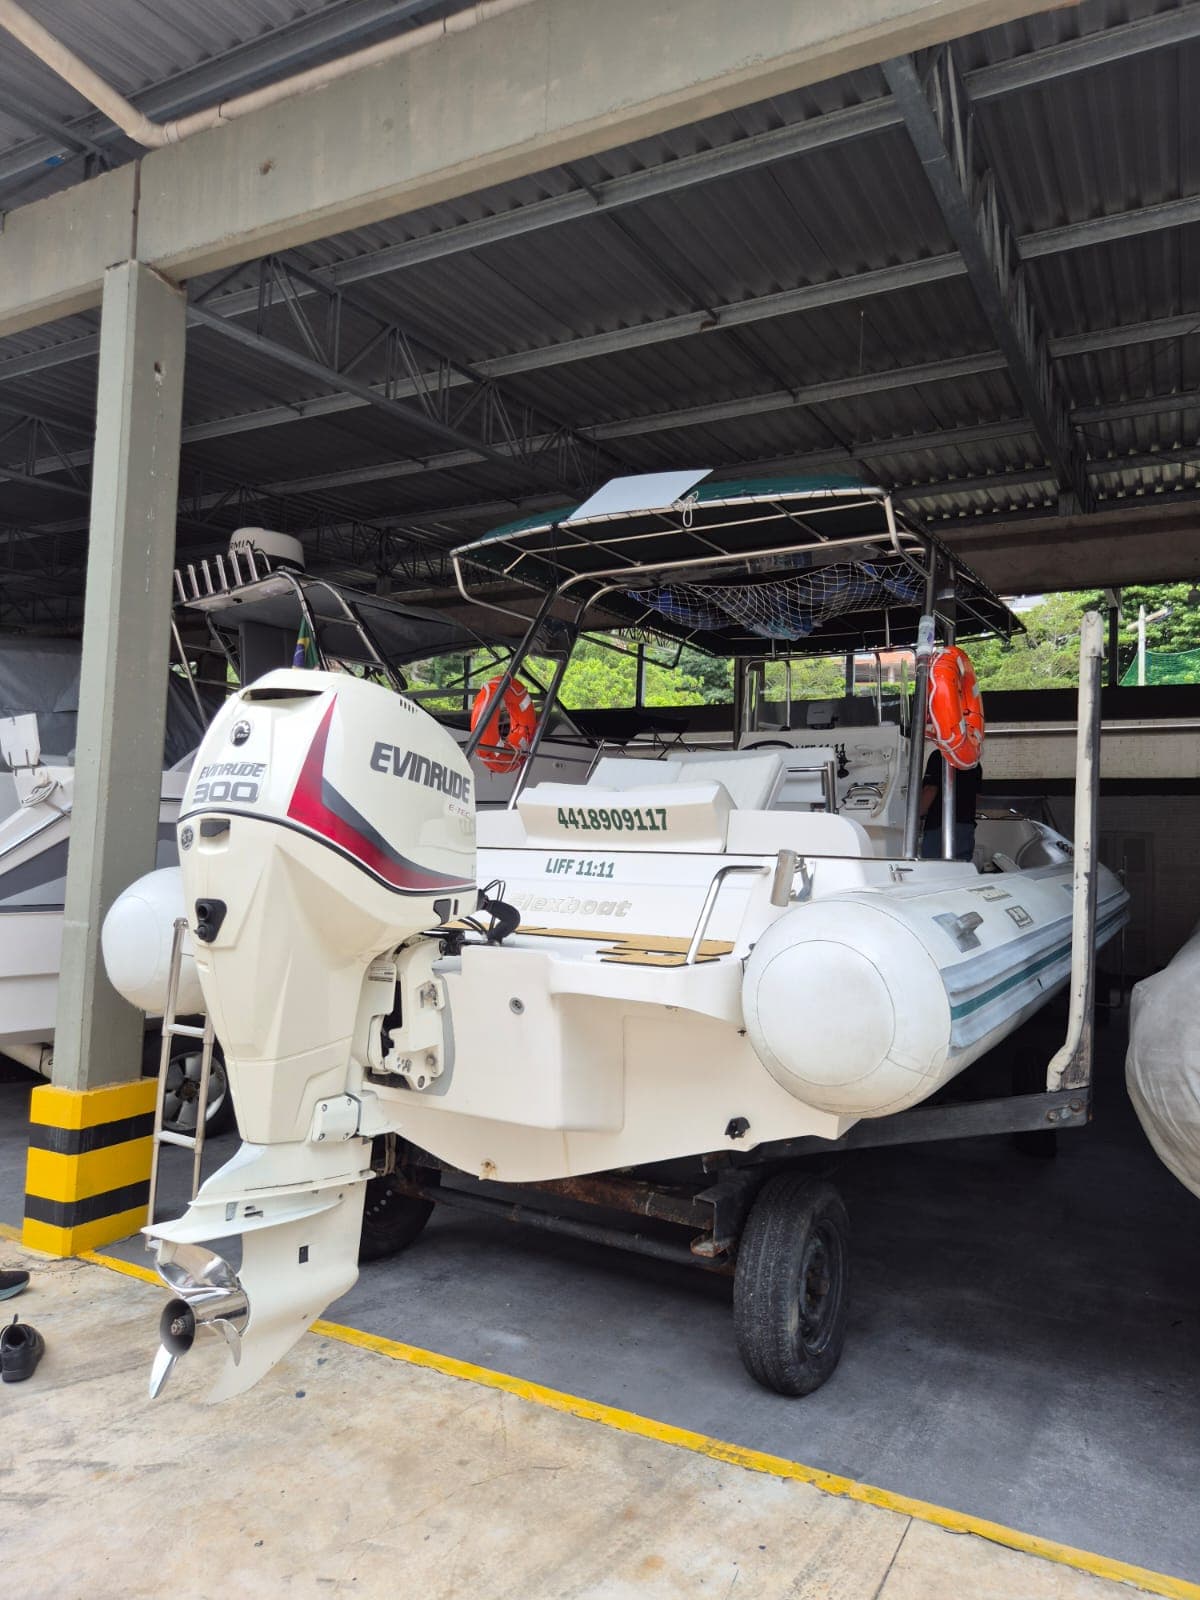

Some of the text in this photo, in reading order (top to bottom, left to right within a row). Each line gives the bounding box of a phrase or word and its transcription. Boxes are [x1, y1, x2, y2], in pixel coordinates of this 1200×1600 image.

[200, 762, 267, 779] EVINRUDE
[370, 741, 471, 804] EVINRUDE
[193, 781, 259, 804] 300
[557, 808, 667, 830] 4418909117
[545, 858, 615, 878] LIFF 11:11
